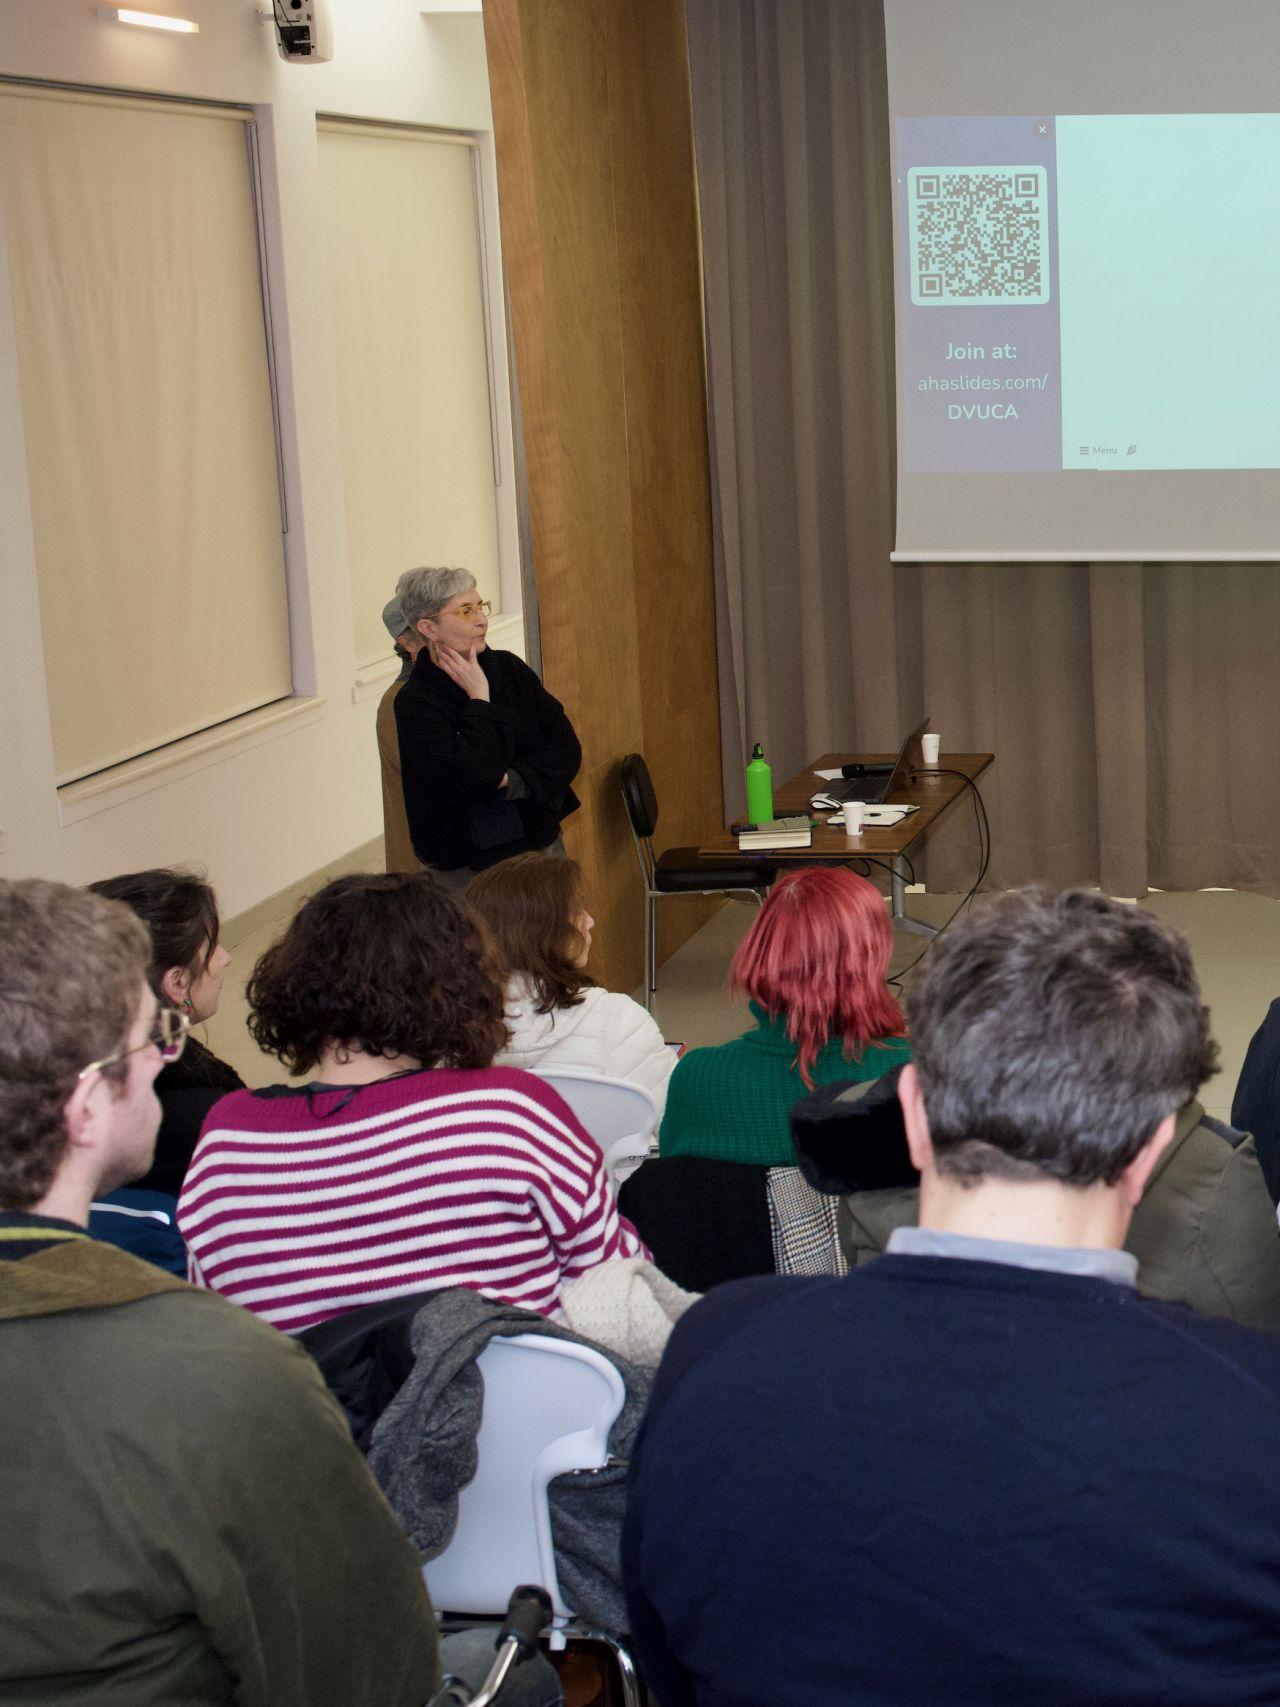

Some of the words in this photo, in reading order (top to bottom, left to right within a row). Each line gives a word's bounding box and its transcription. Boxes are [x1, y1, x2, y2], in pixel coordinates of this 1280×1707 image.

[946, 343, 985, 360] Join
[992, 343, 1017, 359] at:
[918, 373, 1048, 391] ahaslides.com/
[948, 404, 1018, 420] DVUCA
[1092, 446, 1118, 455] Menu
